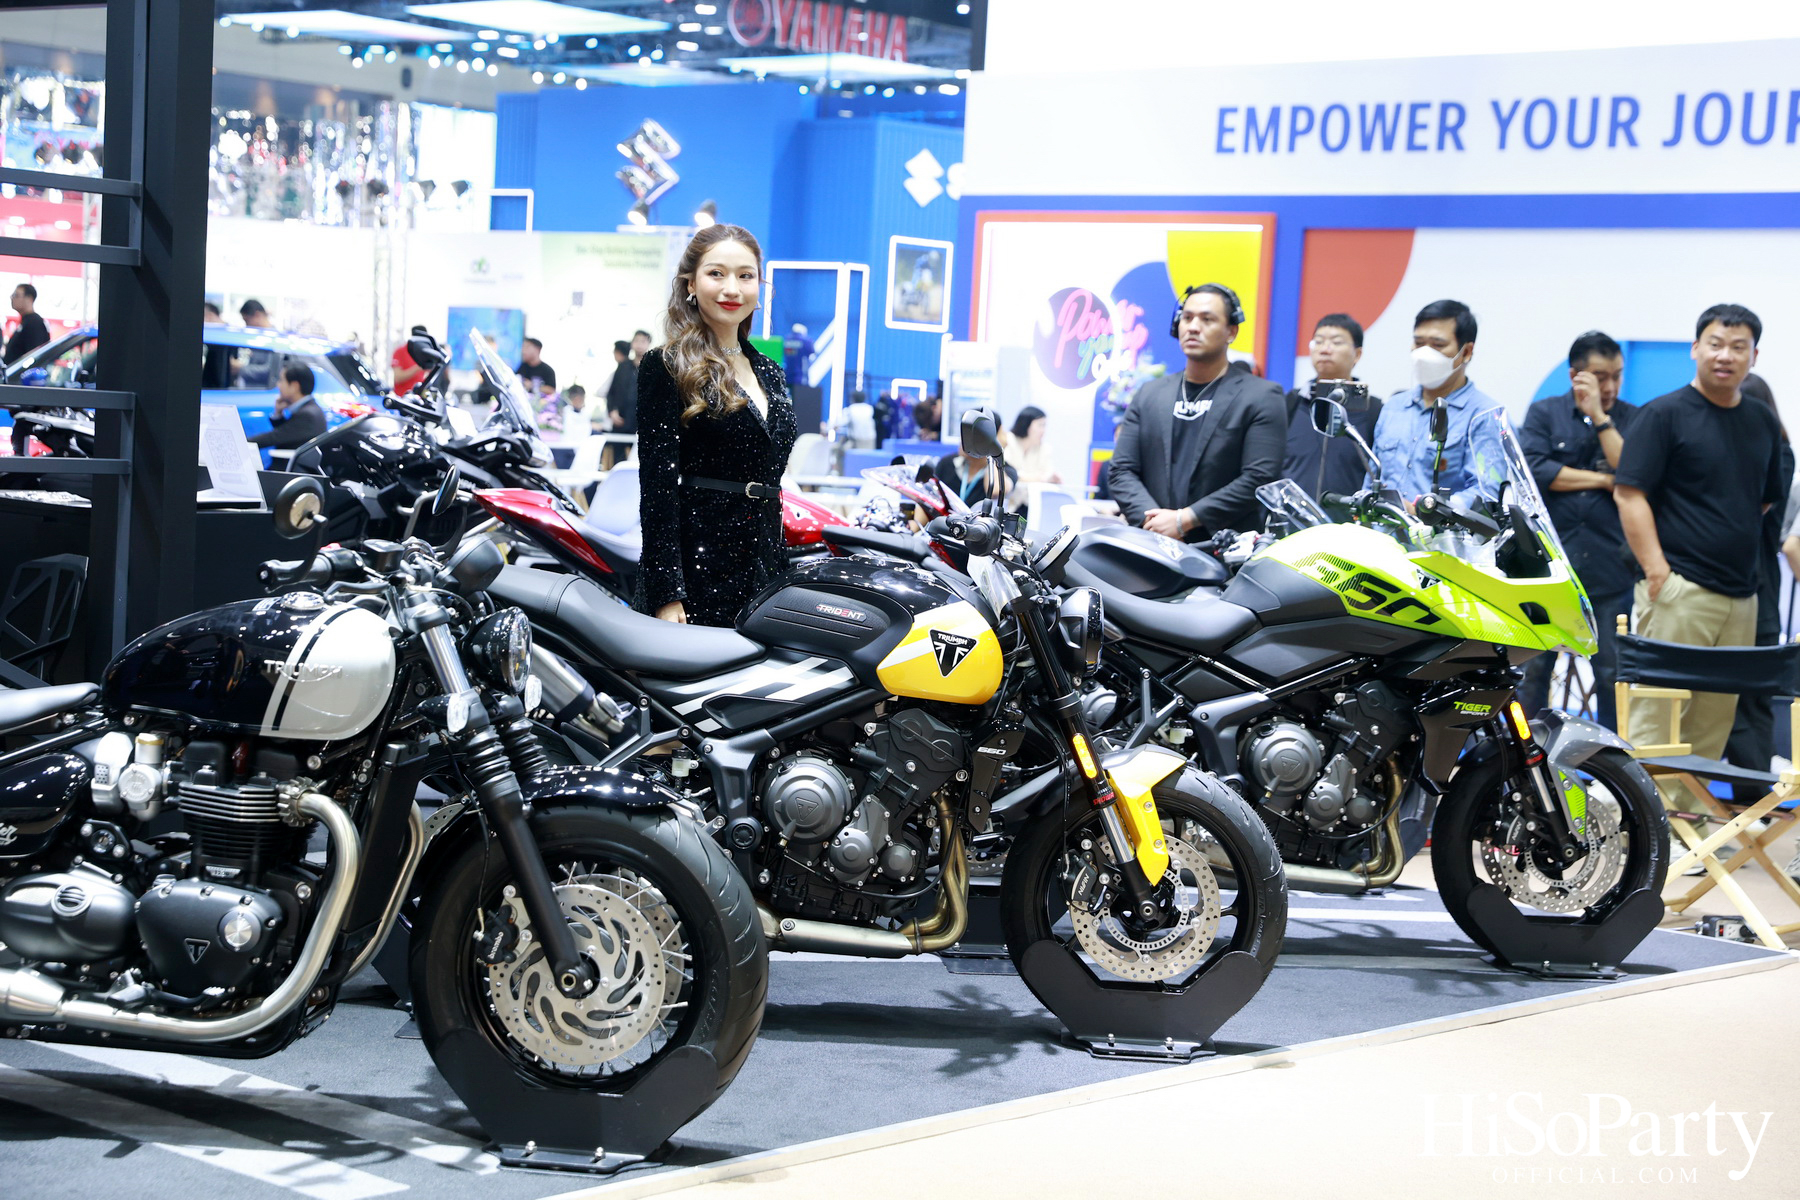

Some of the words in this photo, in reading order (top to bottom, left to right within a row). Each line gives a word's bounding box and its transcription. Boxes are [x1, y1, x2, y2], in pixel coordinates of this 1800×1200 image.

[773, 0, 908, 63] YAMAHA
[1215, 101, 1467, 153] EMPOWER
[1490, 95, 1640, 151] YOUR
[816, 603, 866, 621] TRIDENT
[937, 632, 969, 646] TRIUMPH
[263, 659, 344, 682] TRIUMPH
[1453, 701, 1492, 713] TIGER
[977, 746, 1006, 756] 660
